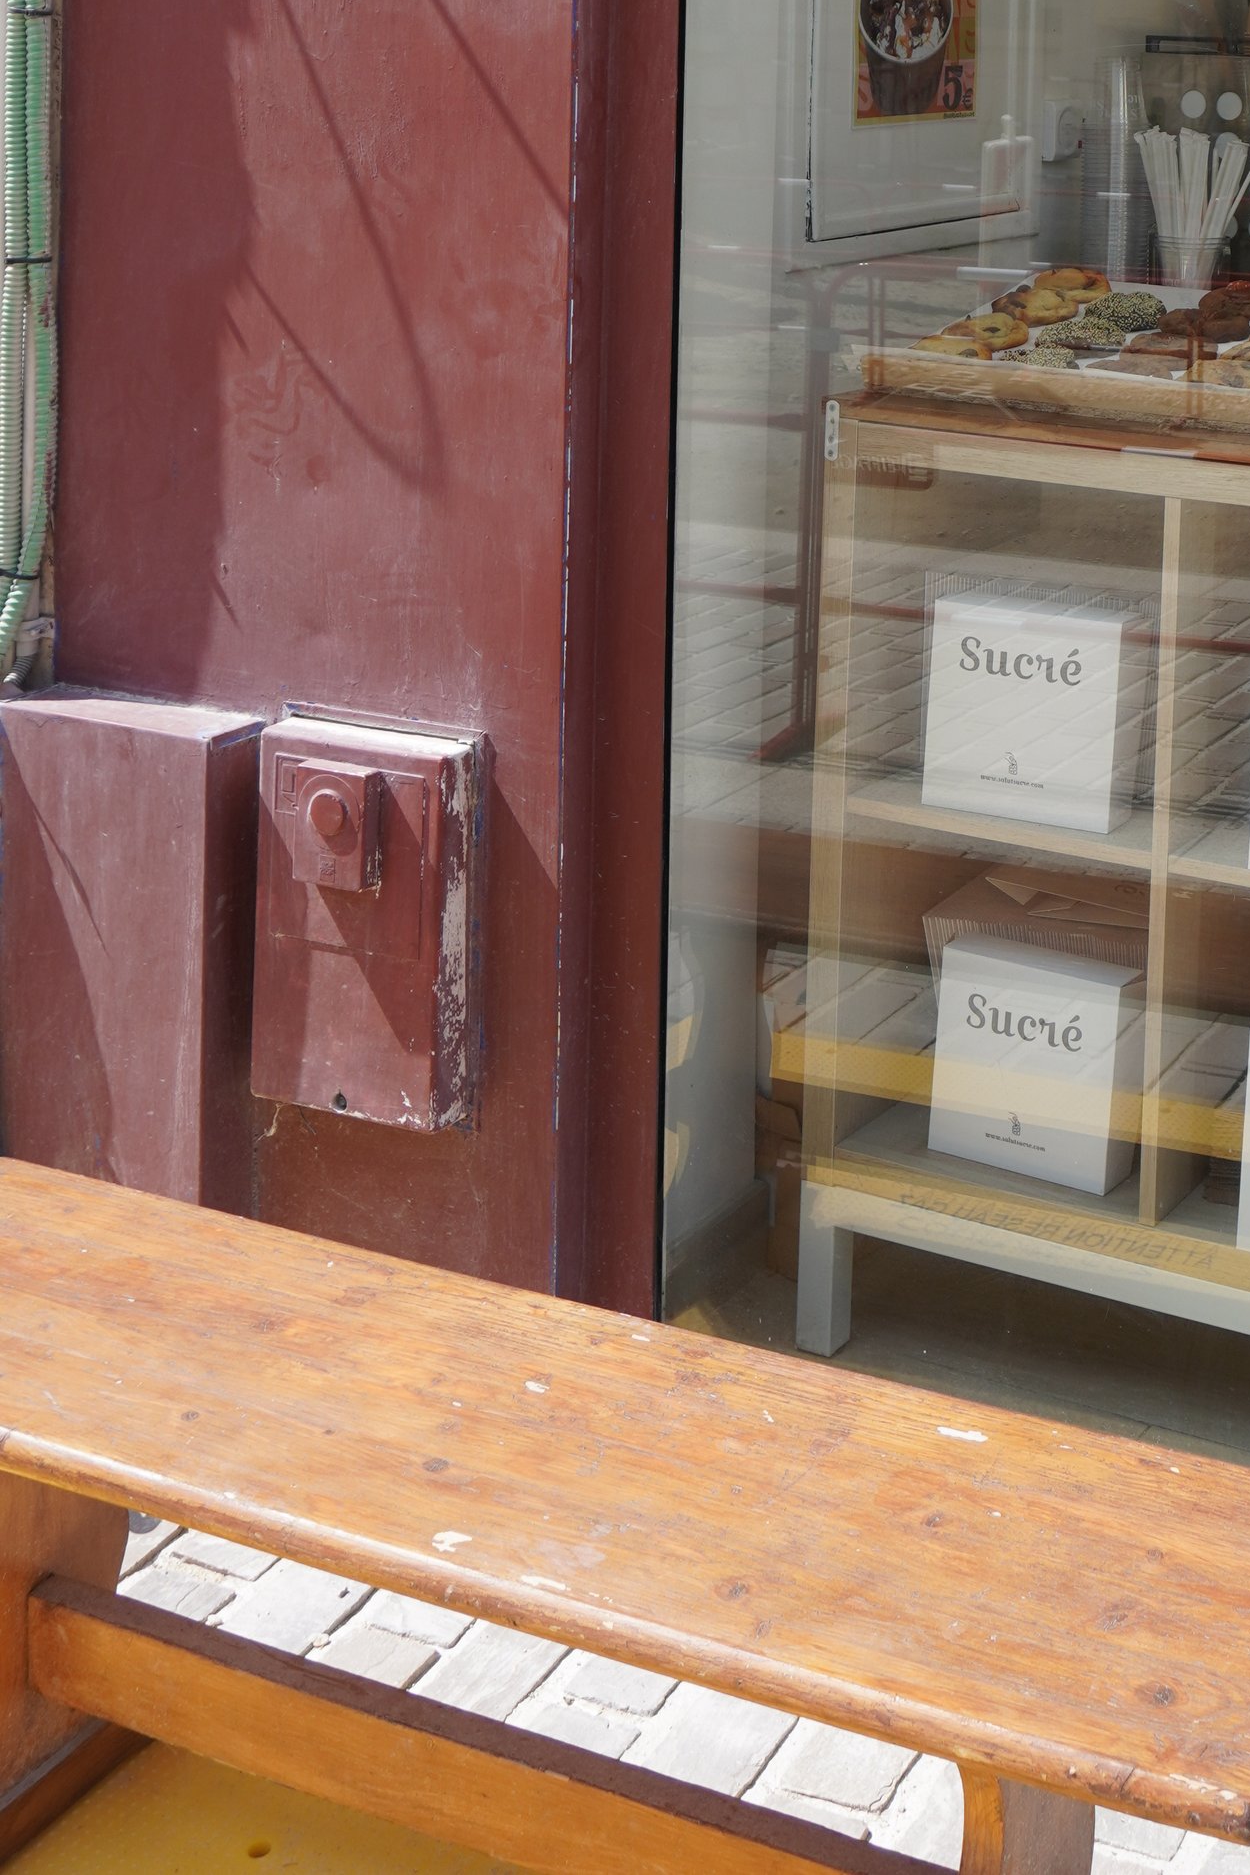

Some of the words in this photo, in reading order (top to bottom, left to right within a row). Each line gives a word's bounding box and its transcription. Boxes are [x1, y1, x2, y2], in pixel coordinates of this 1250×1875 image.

[958, 635, 1083, 688] Sucré
[980, 774, 1044, 789] www.salutsucre.com
[965, 992, 1084, 1054] Sucré
[985, 1132, 1046, 1152] www.salutsucre.com
